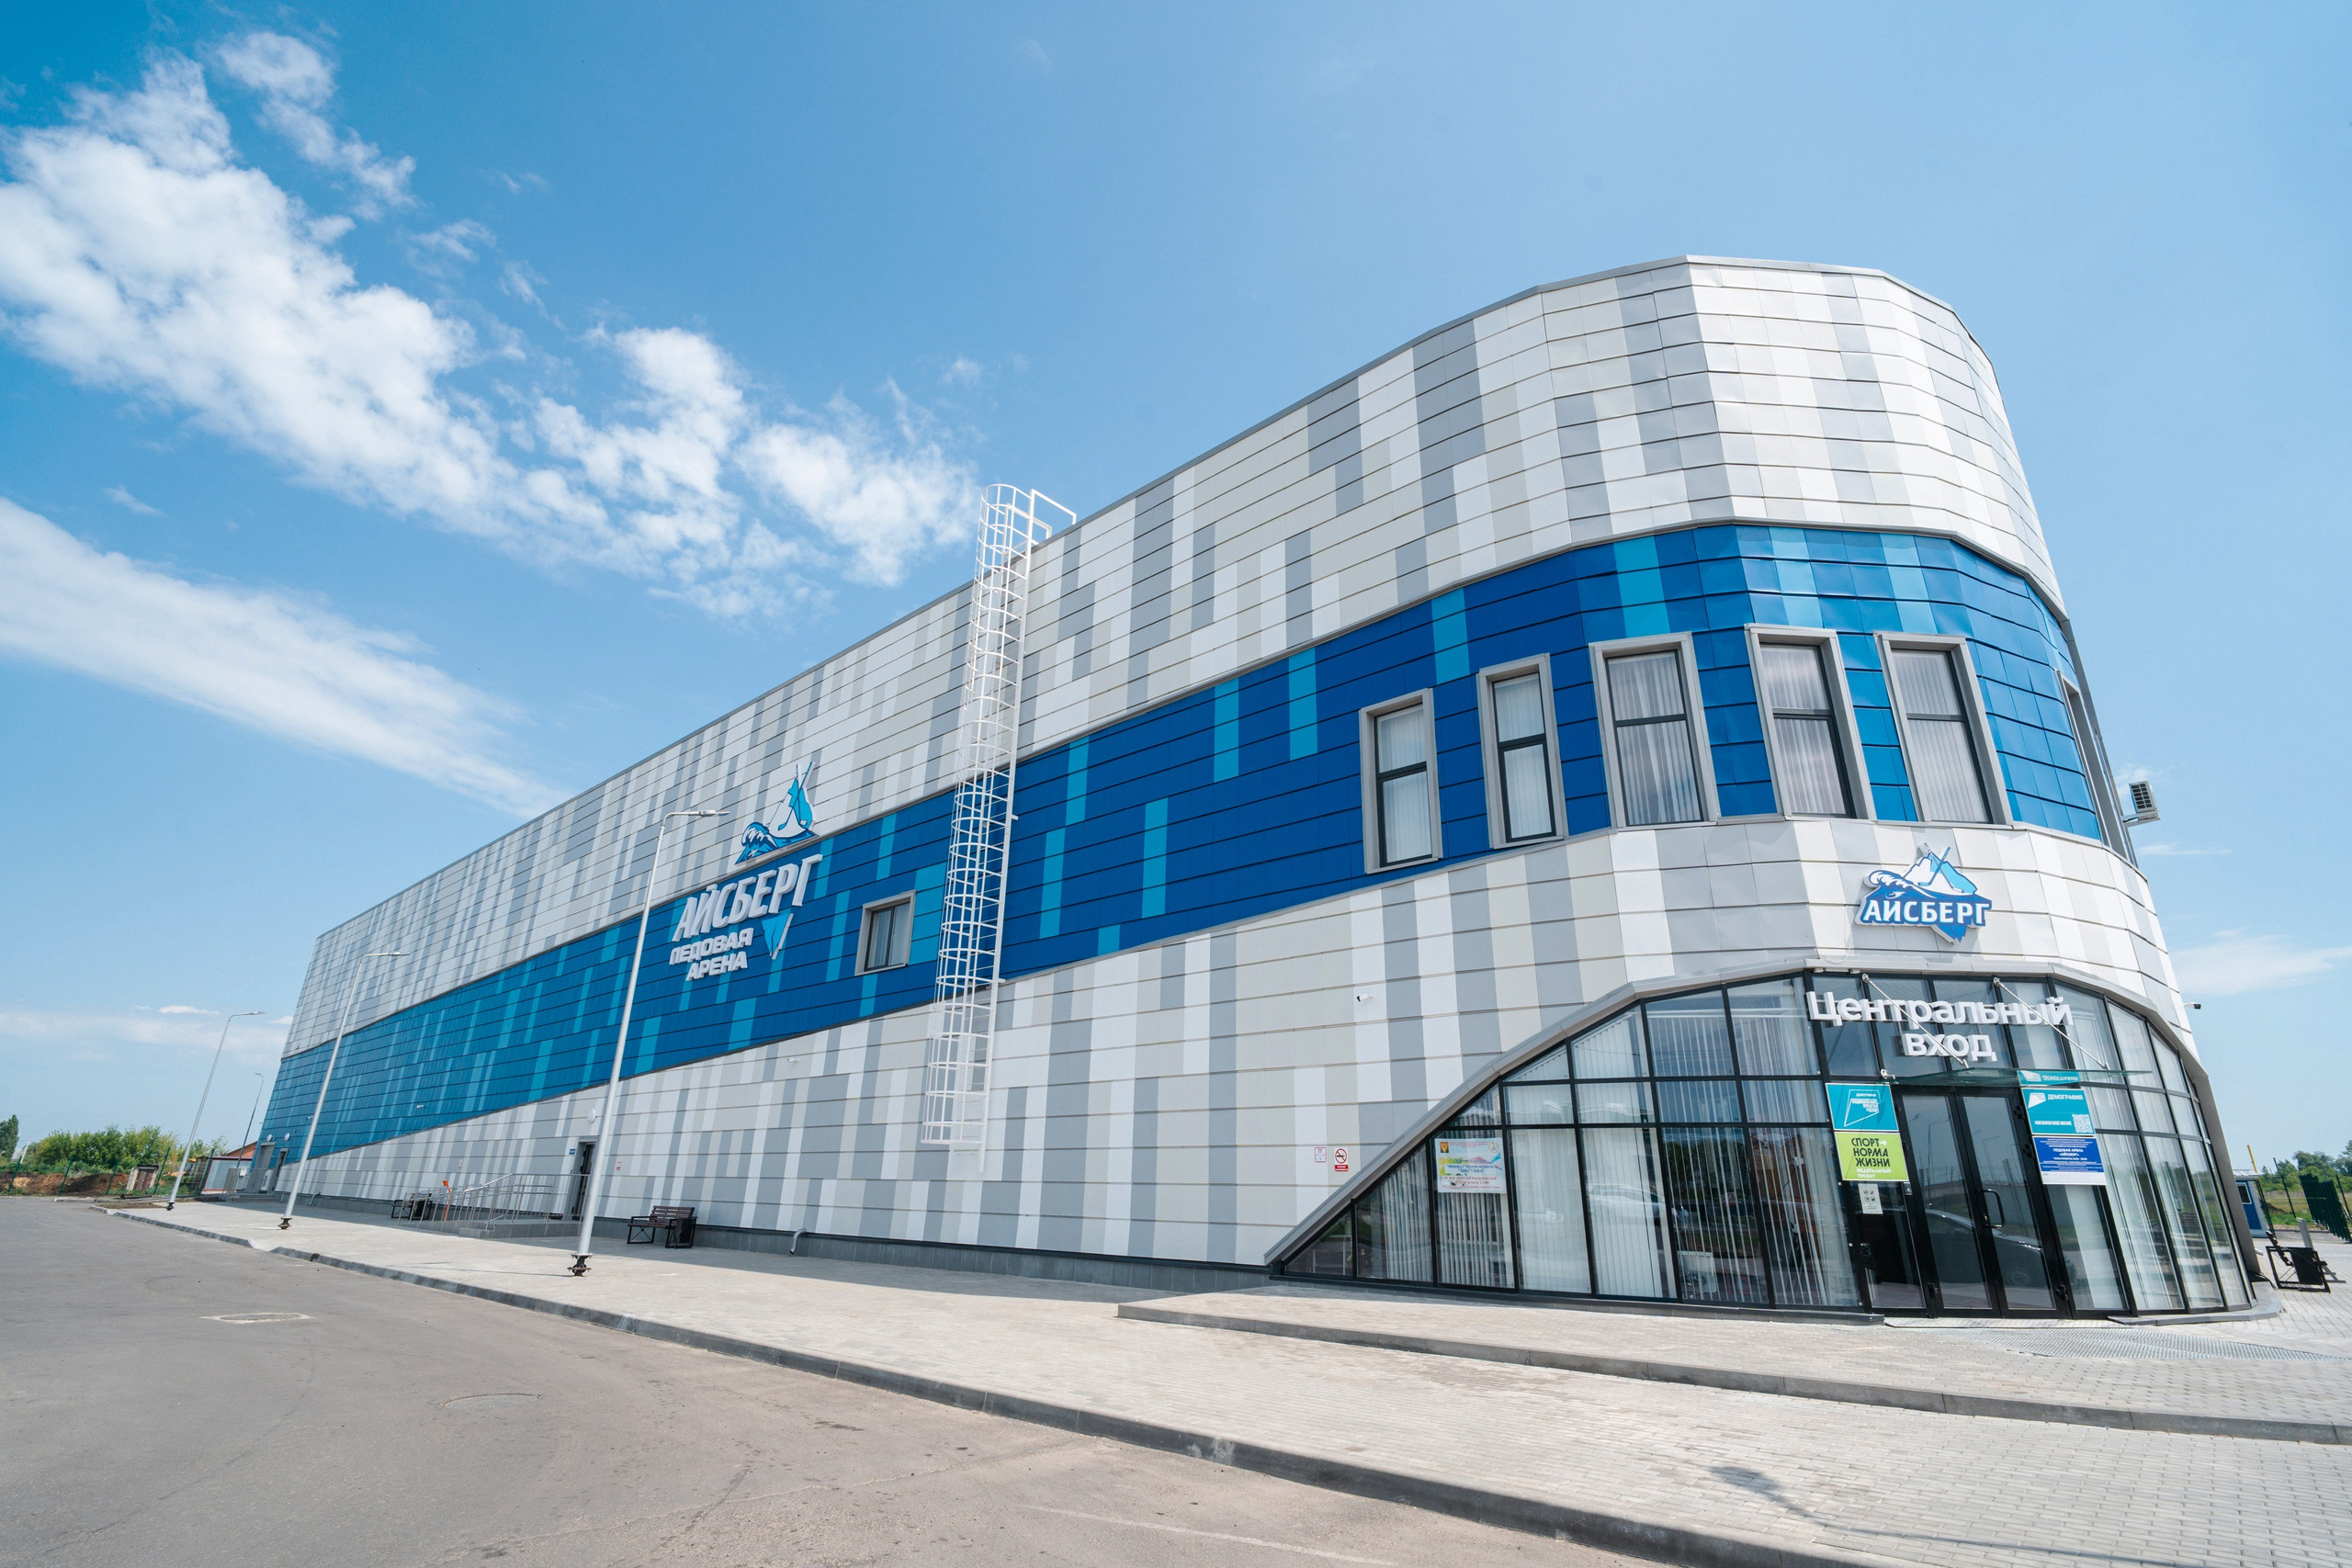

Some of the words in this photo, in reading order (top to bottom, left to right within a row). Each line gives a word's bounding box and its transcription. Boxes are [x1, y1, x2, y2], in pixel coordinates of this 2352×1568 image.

[672, 854, 822, 942] АЙСБЕРГ
[669, 927, 754, 965] ЛЕДОВАЯ
[685, 951, 748, 981] АРЕНА
[1806, 991, 2074, 1030] Центральный
[1902, 1032, 1997, 1062] вход
[1851, 1137, 1879, 1146] СПОРТ
[1853, 1147, 1889, 1157] НОРМА
[1855, 1157, 1891, 1167] ЖИЗНИ
